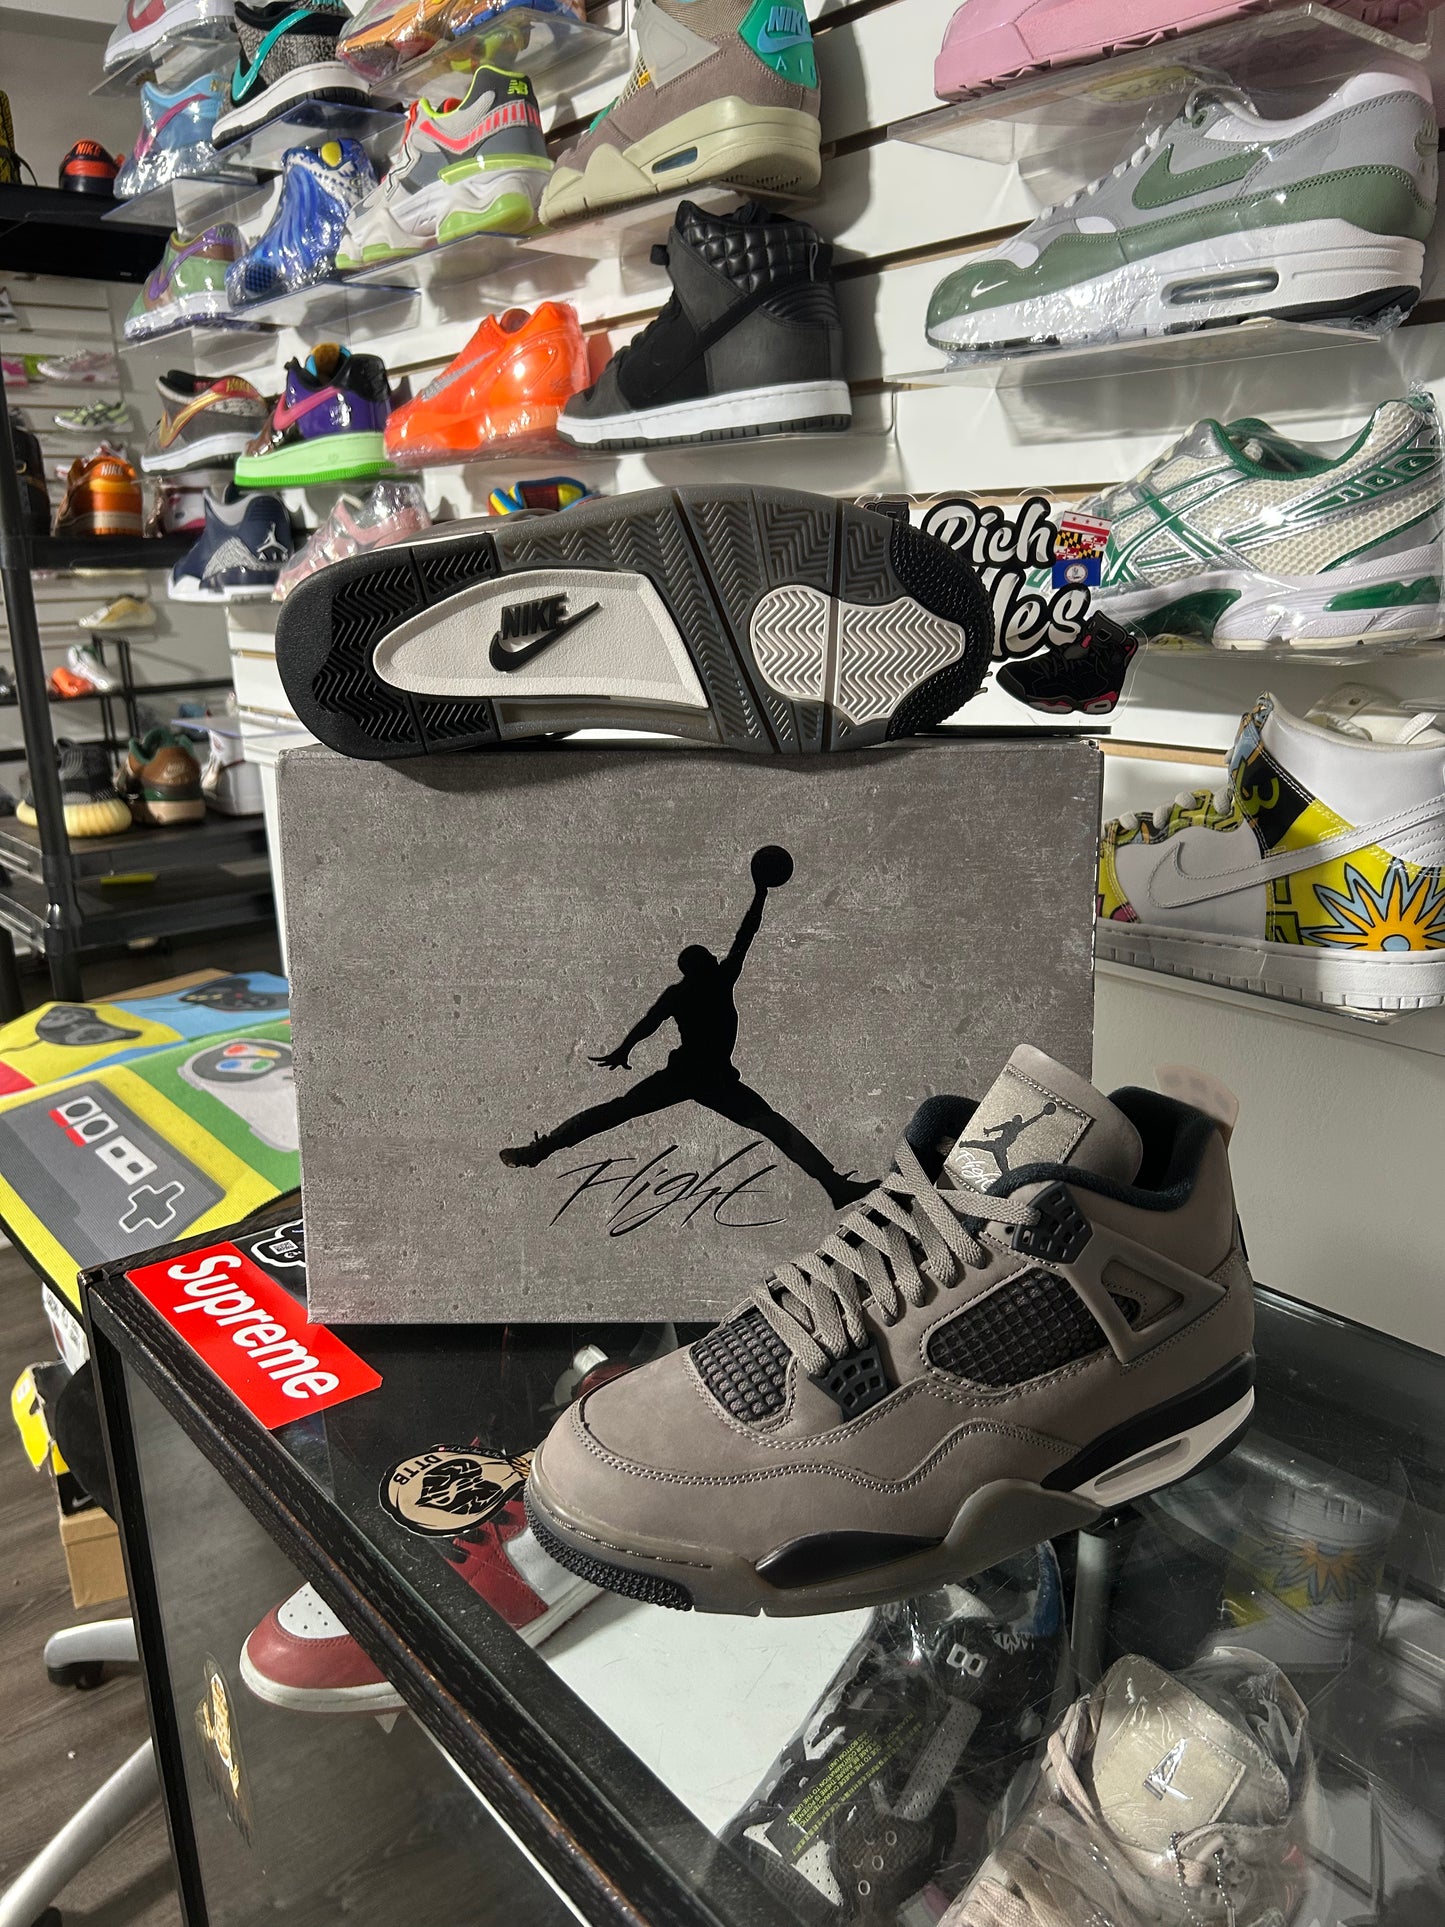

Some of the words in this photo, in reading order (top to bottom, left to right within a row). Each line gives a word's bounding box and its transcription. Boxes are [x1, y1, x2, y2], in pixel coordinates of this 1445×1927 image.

[499, 591, 568, 641] NIKE
[981, 565, 1090, 662] les
[549, 1140, 787, 1238] Flight
[167, 1254, 340, 1399] Supreme
[393, 1454, 443, 1486] DTTB
[837, 1769, 855, 1787] SUEDE
